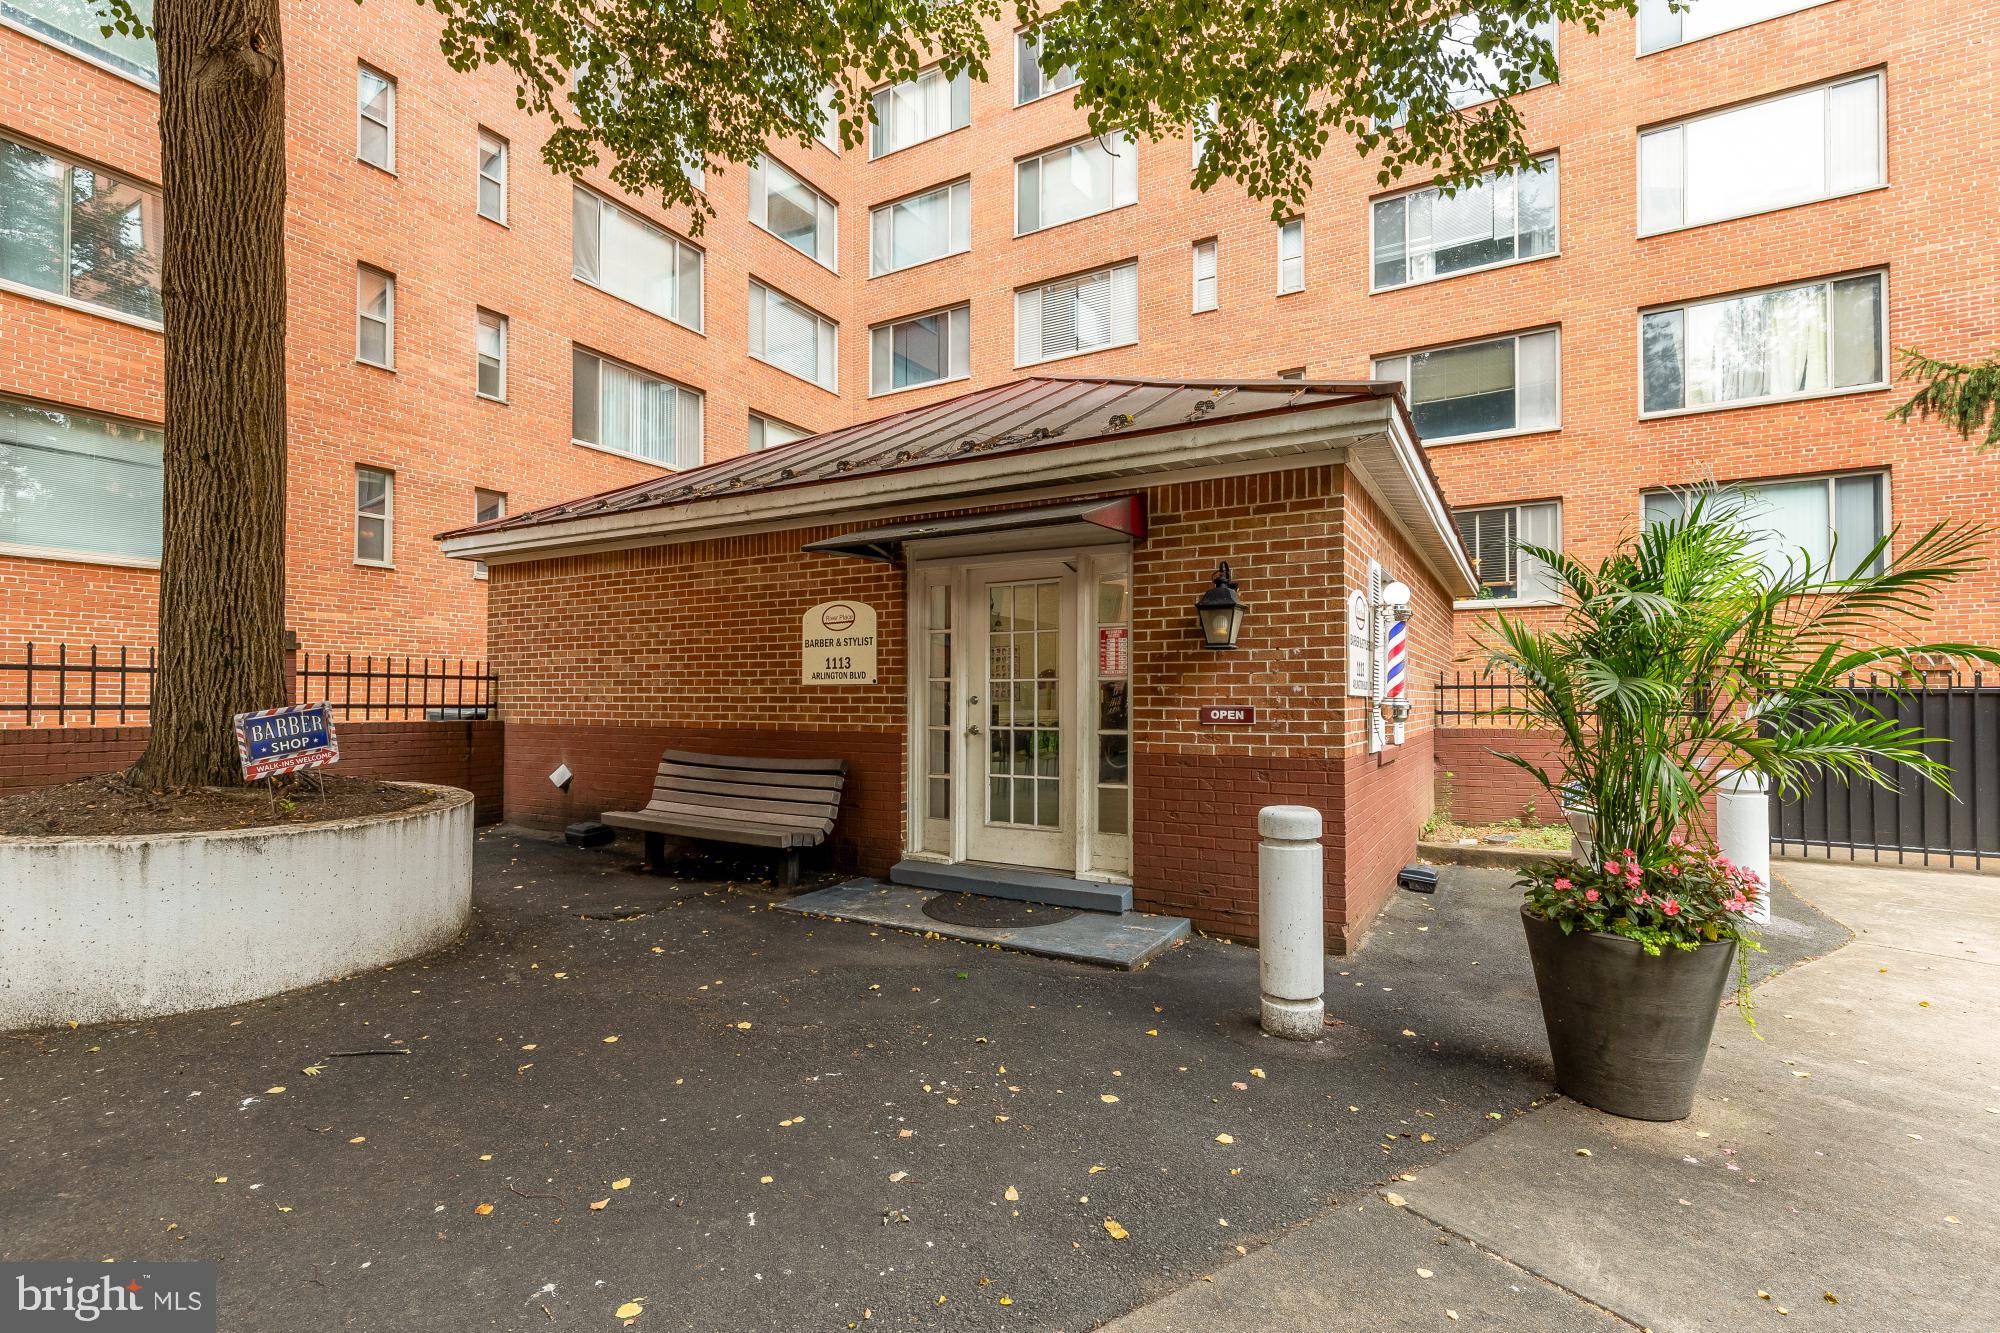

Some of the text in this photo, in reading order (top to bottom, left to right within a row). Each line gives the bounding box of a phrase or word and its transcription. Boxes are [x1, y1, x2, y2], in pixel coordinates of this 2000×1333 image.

[804, 636, 873, 648] BARBER & STYLIST
[825, 656, 851, 670] 1113
[811, 671, 866, 680] ARLINGTON BLVD
[1210, 710, 1244, 720] OPEN
[251, 715, 322, 742] BARBER
[271, 737, 310, 753] SHOP
[256, 752, 332, 773] WALK-INS WELCOME
